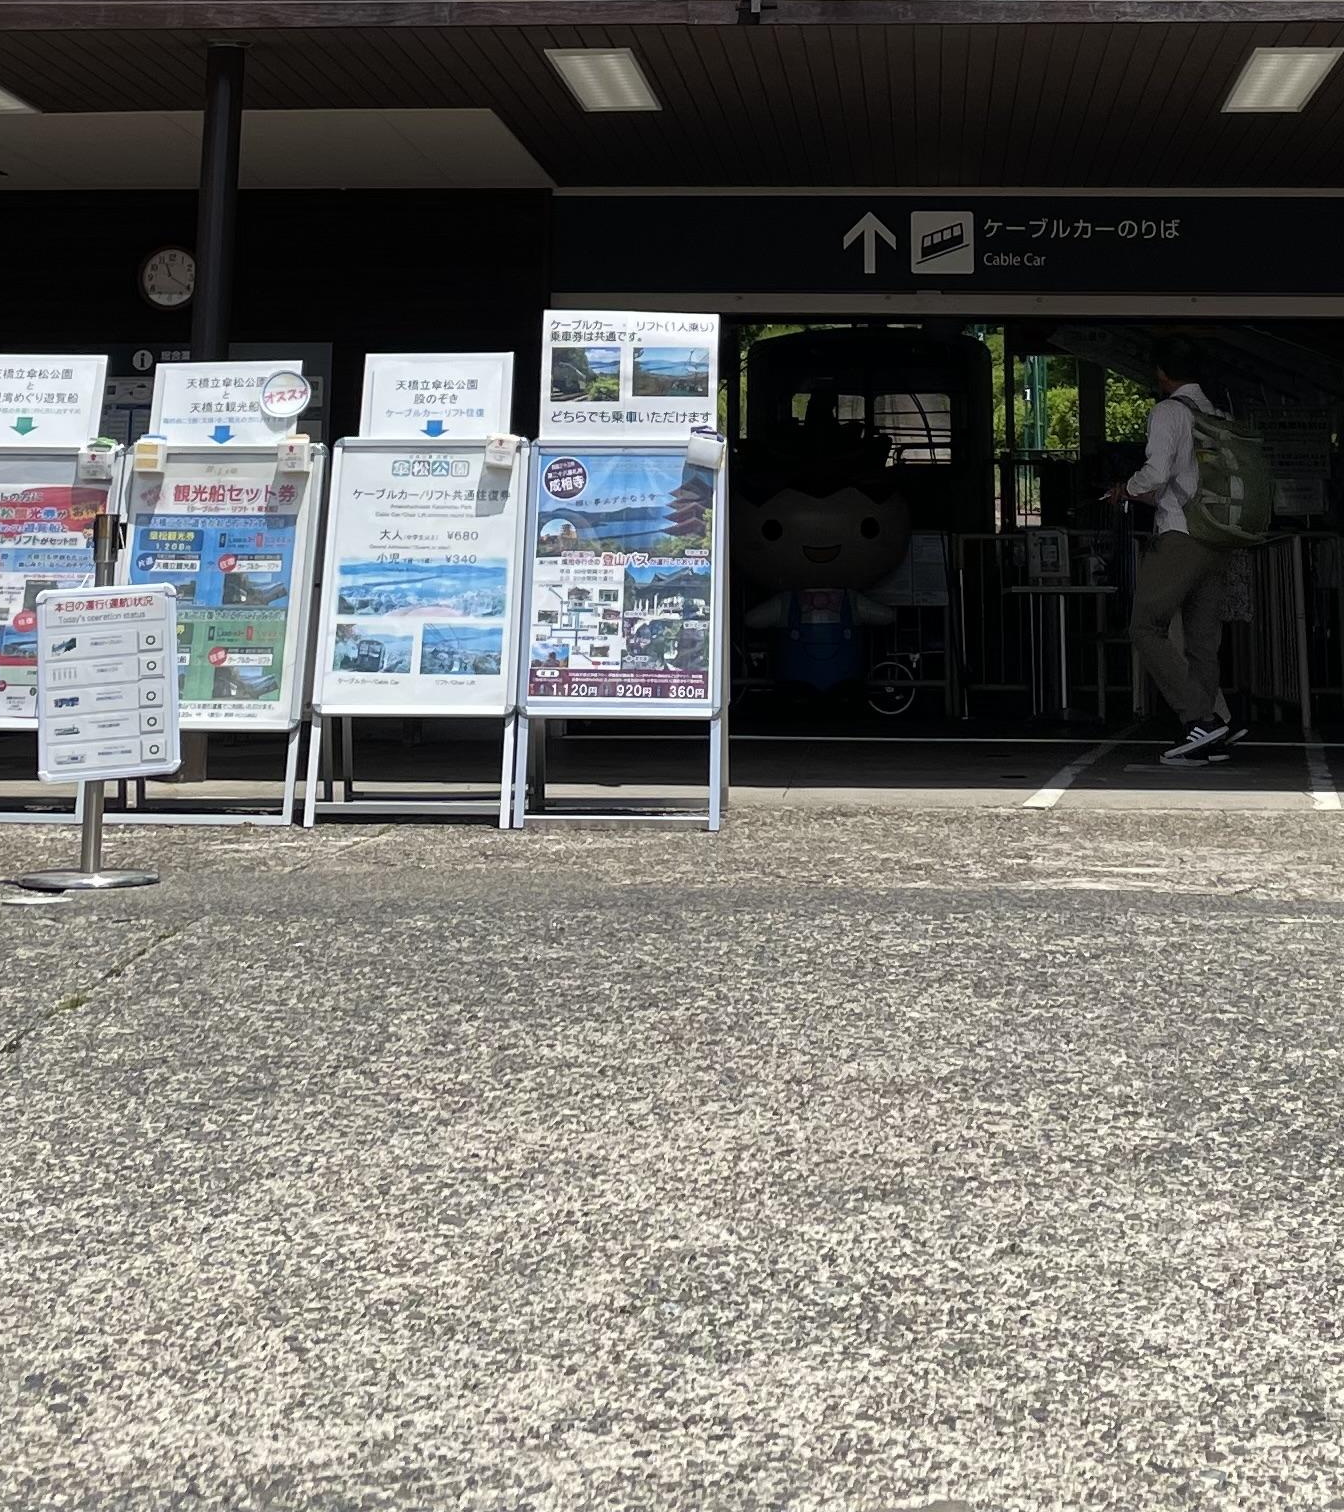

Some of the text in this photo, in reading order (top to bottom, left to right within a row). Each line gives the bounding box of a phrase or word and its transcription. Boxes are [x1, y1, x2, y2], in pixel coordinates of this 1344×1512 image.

[983, 218, 1181, 238] ケーブルカーのりば
[983, 252, 1047, 266] Cable Car
[550, 331, 643, 342] 乗車券は共通です。
[395, 379, 479, 391] 天橋立傘松公園
[264, 388, 309, 405] オススメ
[413, 393, 458, 405] 股のぞき
[550, 410, 712, 424] どちらでも乗車いただけます
[548, 475, 586, 492] 成相寺
[173, 483, 297, 504] 観光船セット券
[379, 529, 403, 541] 大人
[376, 552, 400, 565] 小児
[616, 684, 652, 698] 920円
[668, 684, 705, 699] 360円
